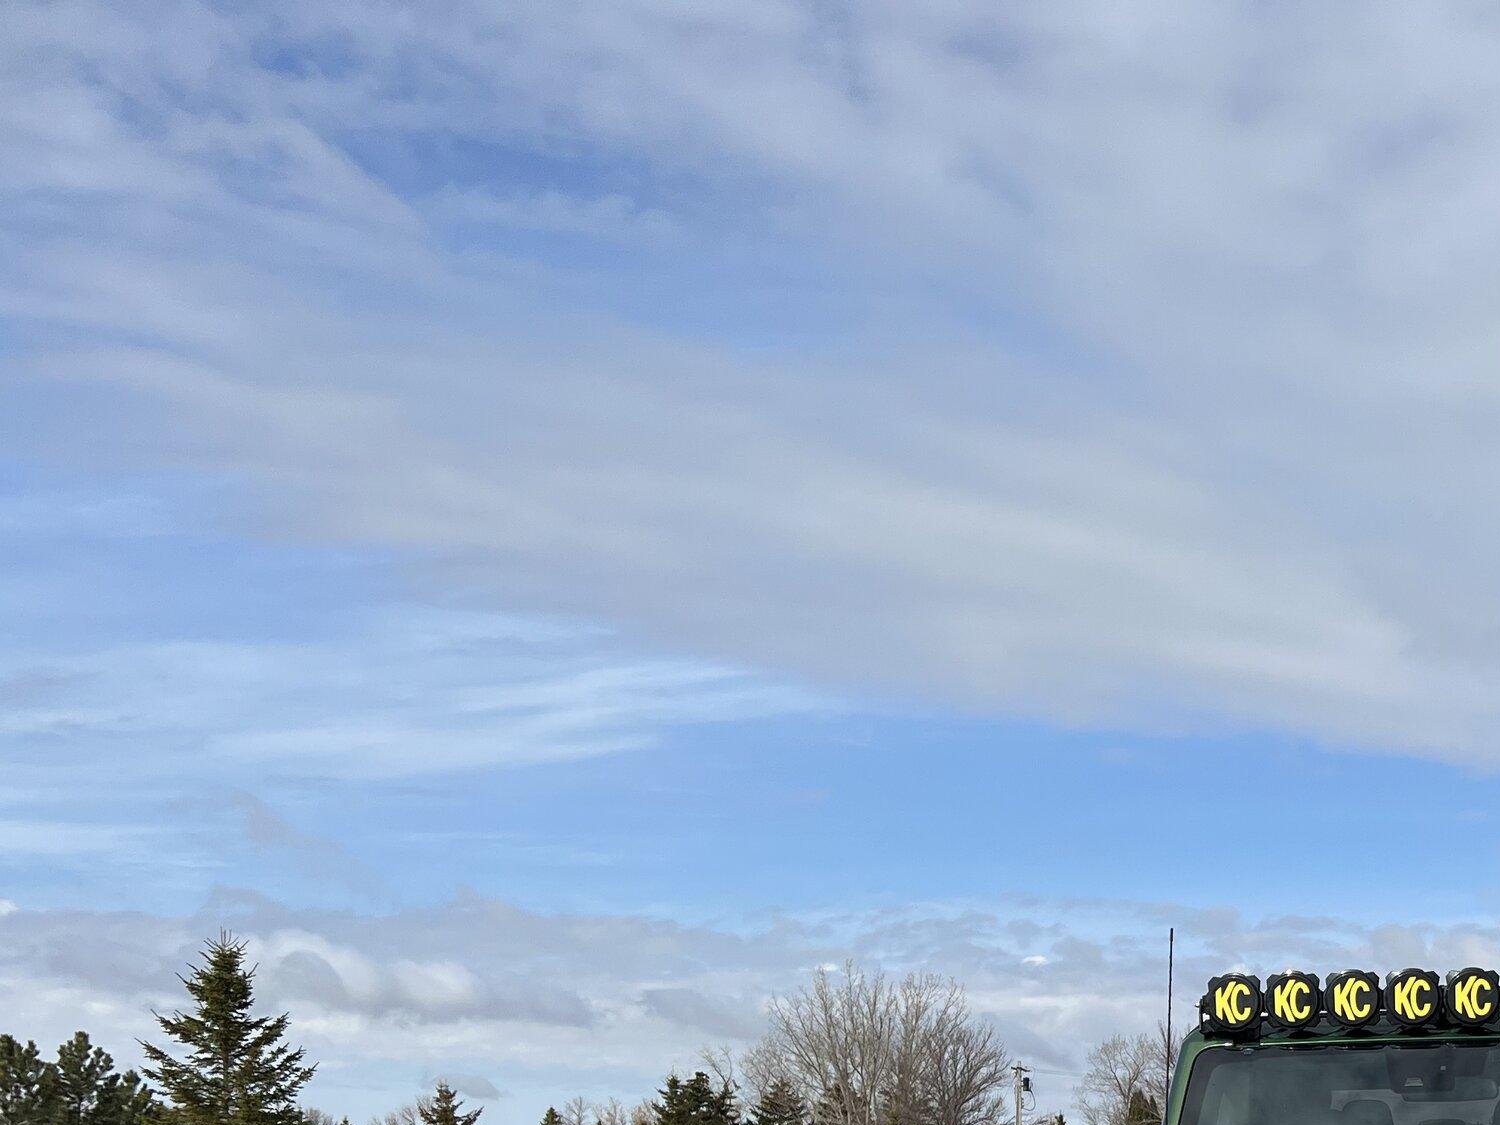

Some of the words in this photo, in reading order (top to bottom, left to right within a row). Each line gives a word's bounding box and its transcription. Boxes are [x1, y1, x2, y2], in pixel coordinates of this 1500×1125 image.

[1216, 981, 1251, 1022] KC
[1276, 981, 1311, 1020] KC
[1335, 979, 1370, 1019] KC
[1396, 978, 1431, 1018] KC
[1456, 977, 1491, 1018] KC
